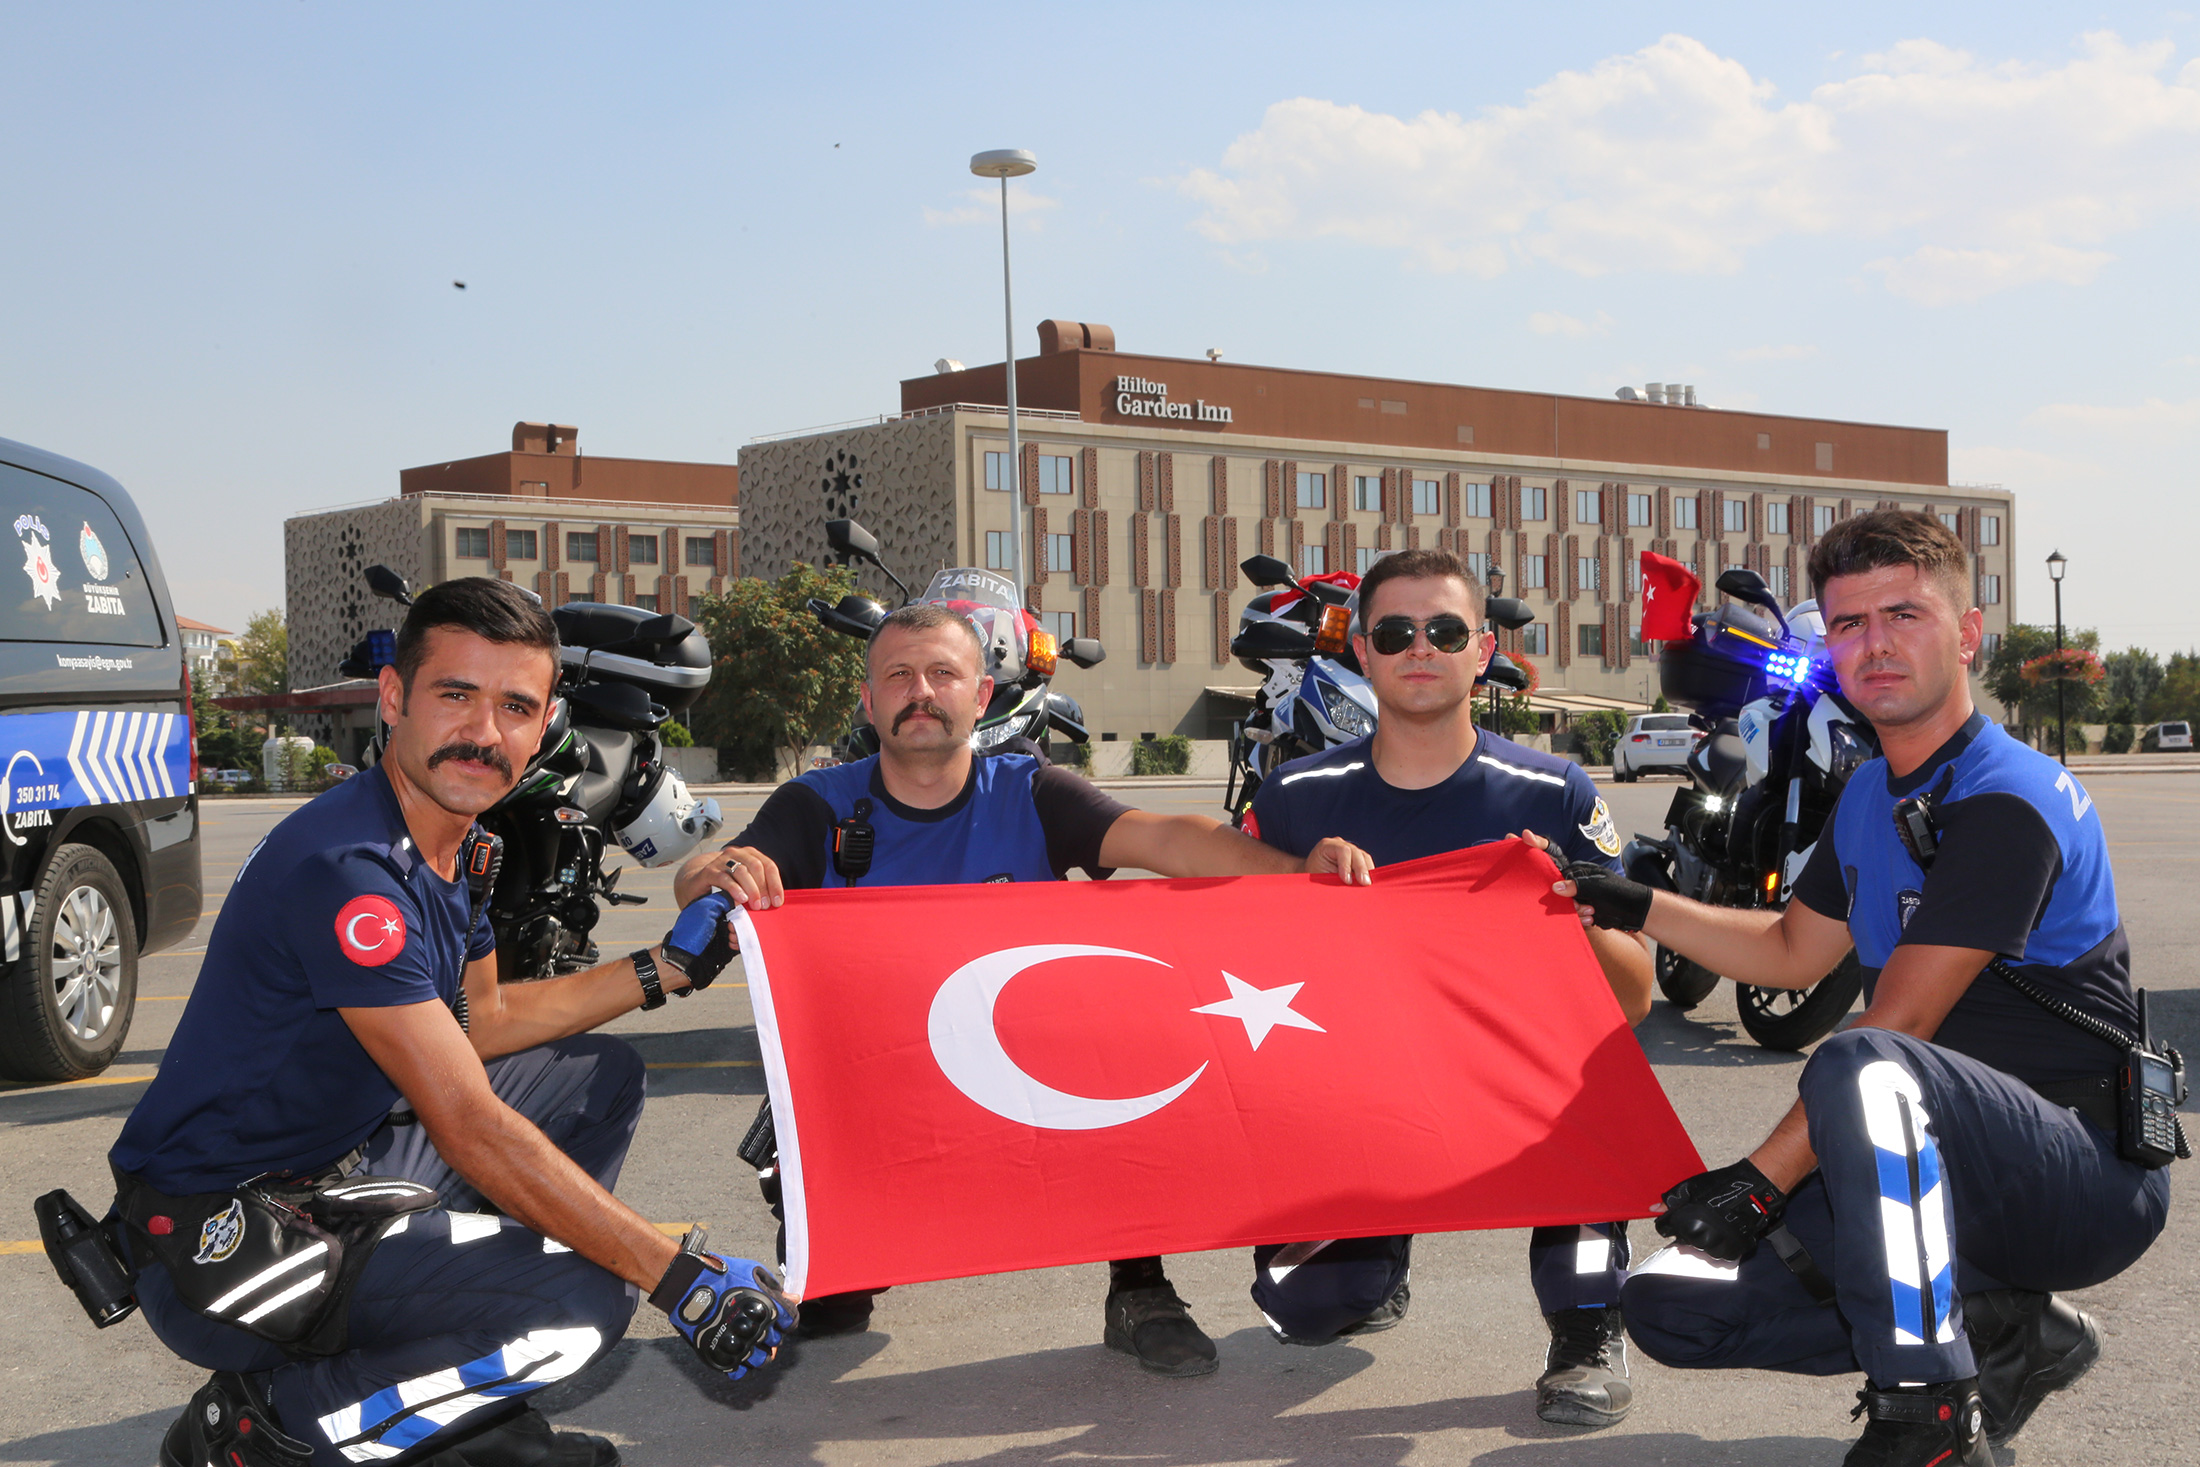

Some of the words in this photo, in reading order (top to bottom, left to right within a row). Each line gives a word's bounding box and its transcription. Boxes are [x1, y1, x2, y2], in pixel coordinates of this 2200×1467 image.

[1117, 375, 1168, 395] Hilton
[1117, 393, 1193, 420] Garden
[1197, 399, 1233, 423] Inn
[939, 573, 1010, 601] ZABITA
[85, 595, 126, 616] ZABITA
[16, 786, 35, 804] 350
[35, 785, 46, 802] 31
[48, 783, 61, 801] 74
[2054, 770, 2092, 822] Z
[14, 809, 53, 829] ZABITA
